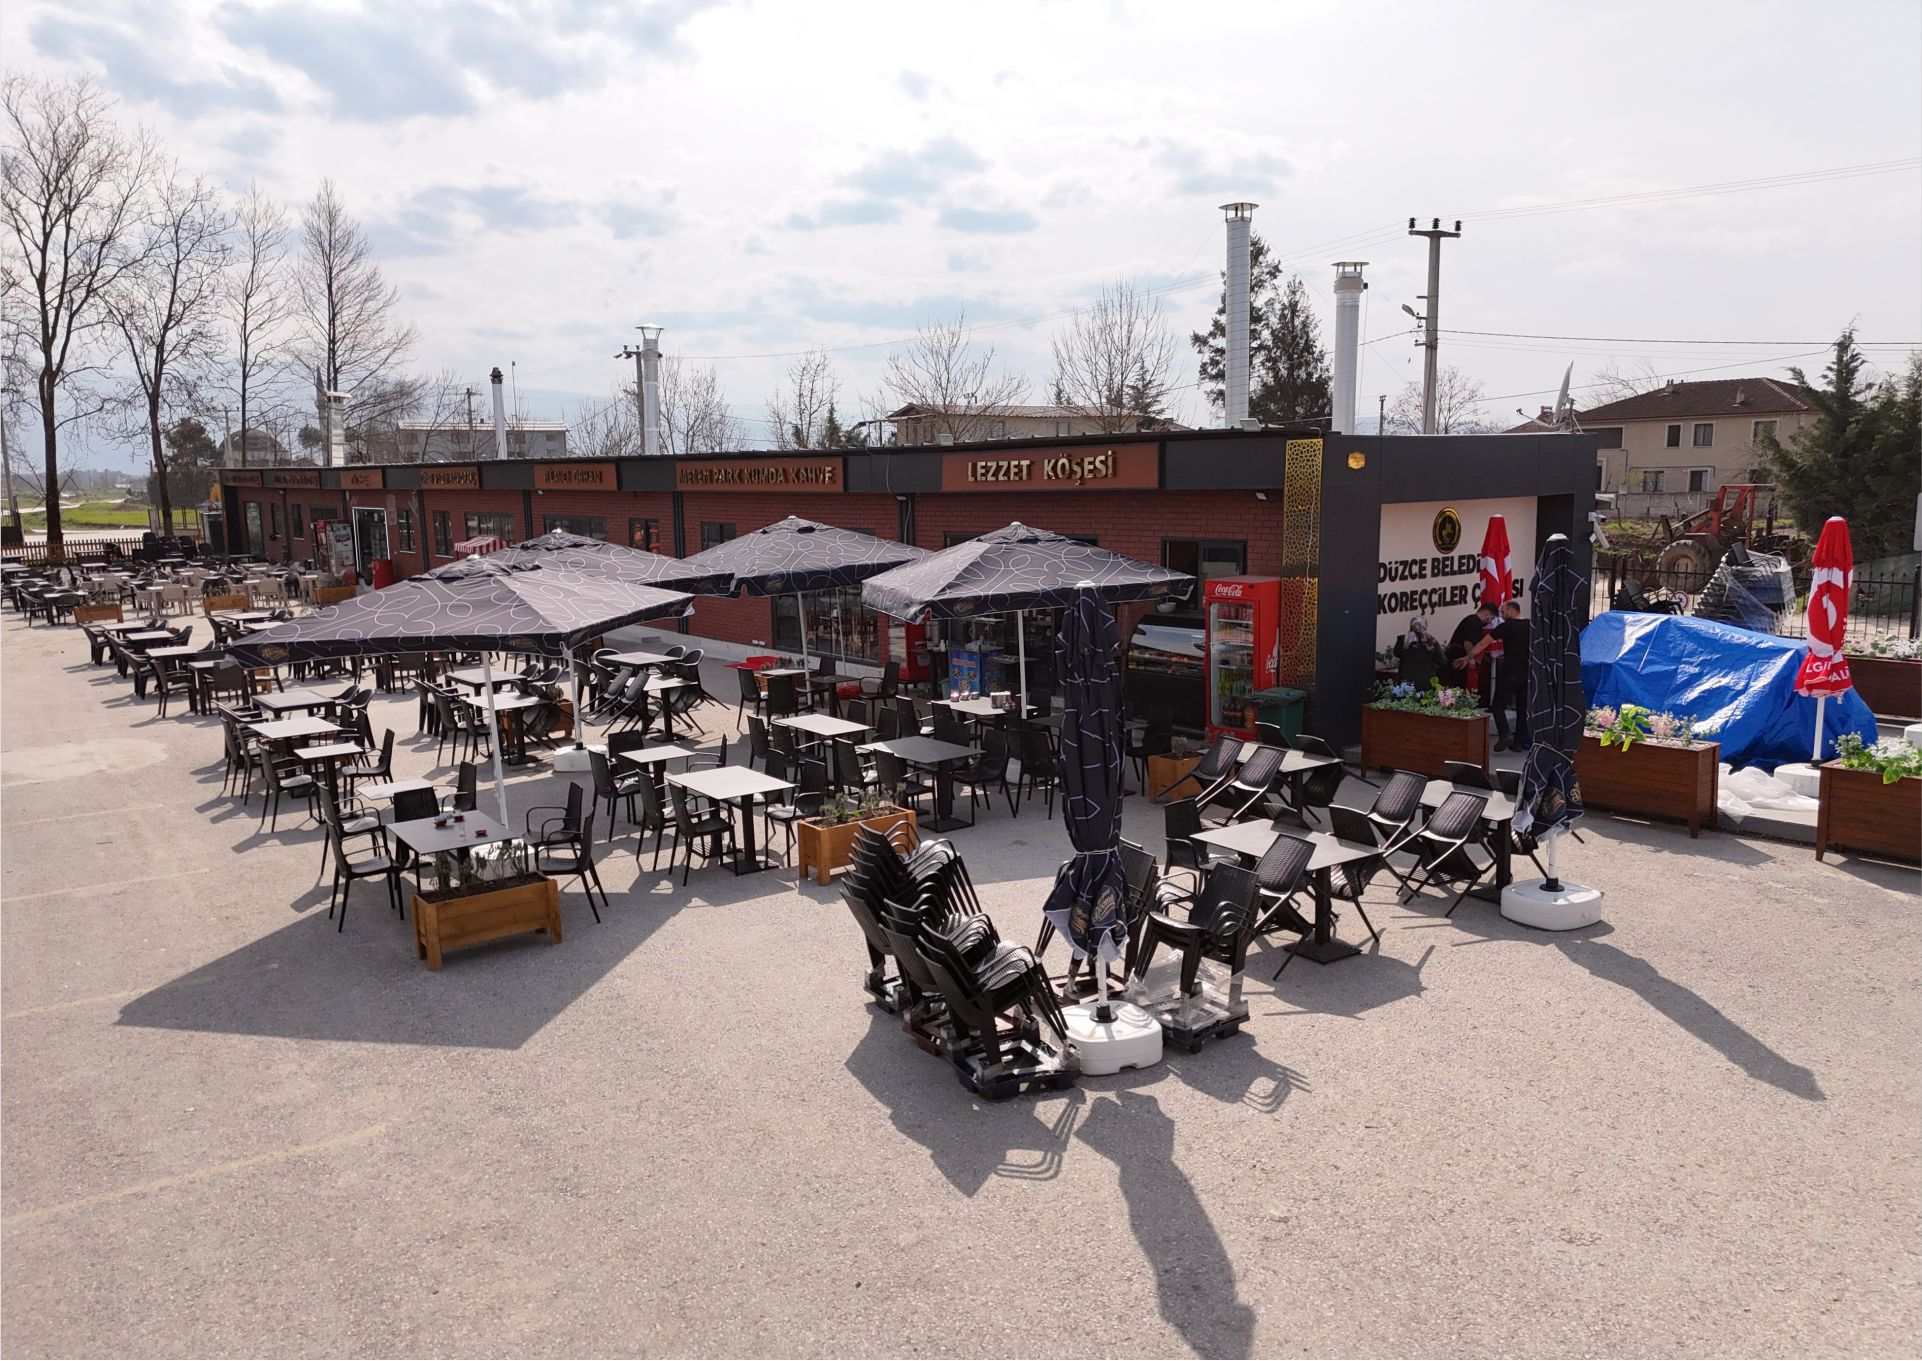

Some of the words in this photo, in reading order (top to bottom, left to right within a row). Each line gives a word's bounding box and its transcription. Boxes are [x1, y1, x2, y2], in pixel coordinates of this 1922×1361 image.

[713, 466, 741, 485] PARK
[744, 466, 785, 484] KUMDA
[790, 465, 835, 484] KAHVE
[967, 459, 1032, 482] LEZZET
[1043, 450, 1115, 486] KÖŞESİ
[1378, 558, 1427, 583] DÜZCE
[1430, 554, 1481, 578] BELEDİ
[1376, 585, 1468, 616] KOREÇÇİLER
